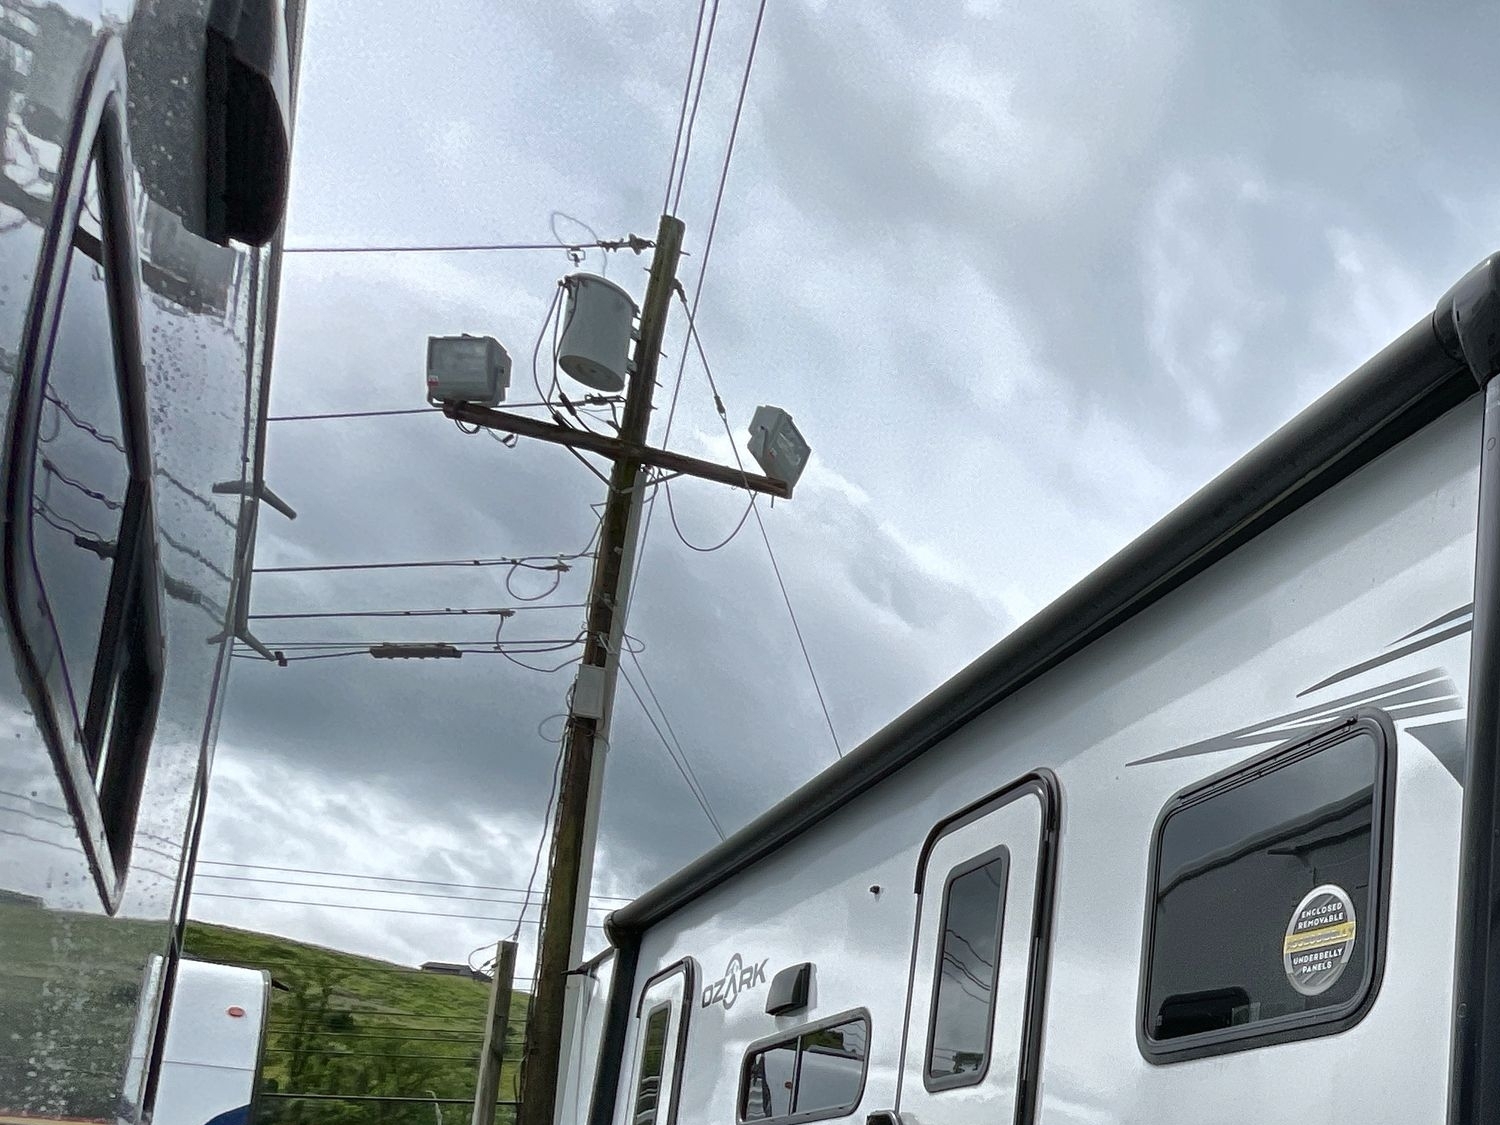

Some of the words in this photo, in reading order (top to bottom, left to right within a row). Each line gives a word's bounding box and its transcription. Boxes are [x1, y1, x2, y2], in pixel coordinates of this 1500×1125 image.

[1301, 902, 1342, 918] ENCLOSED
[1297, 912, 1344, 930] REMOVABLE
[1293, 948, 1343, 965] UNDERBELLY
[1302, 961, 1332, 973] PANELS
[702, 953, 769, 1010] OZARK
